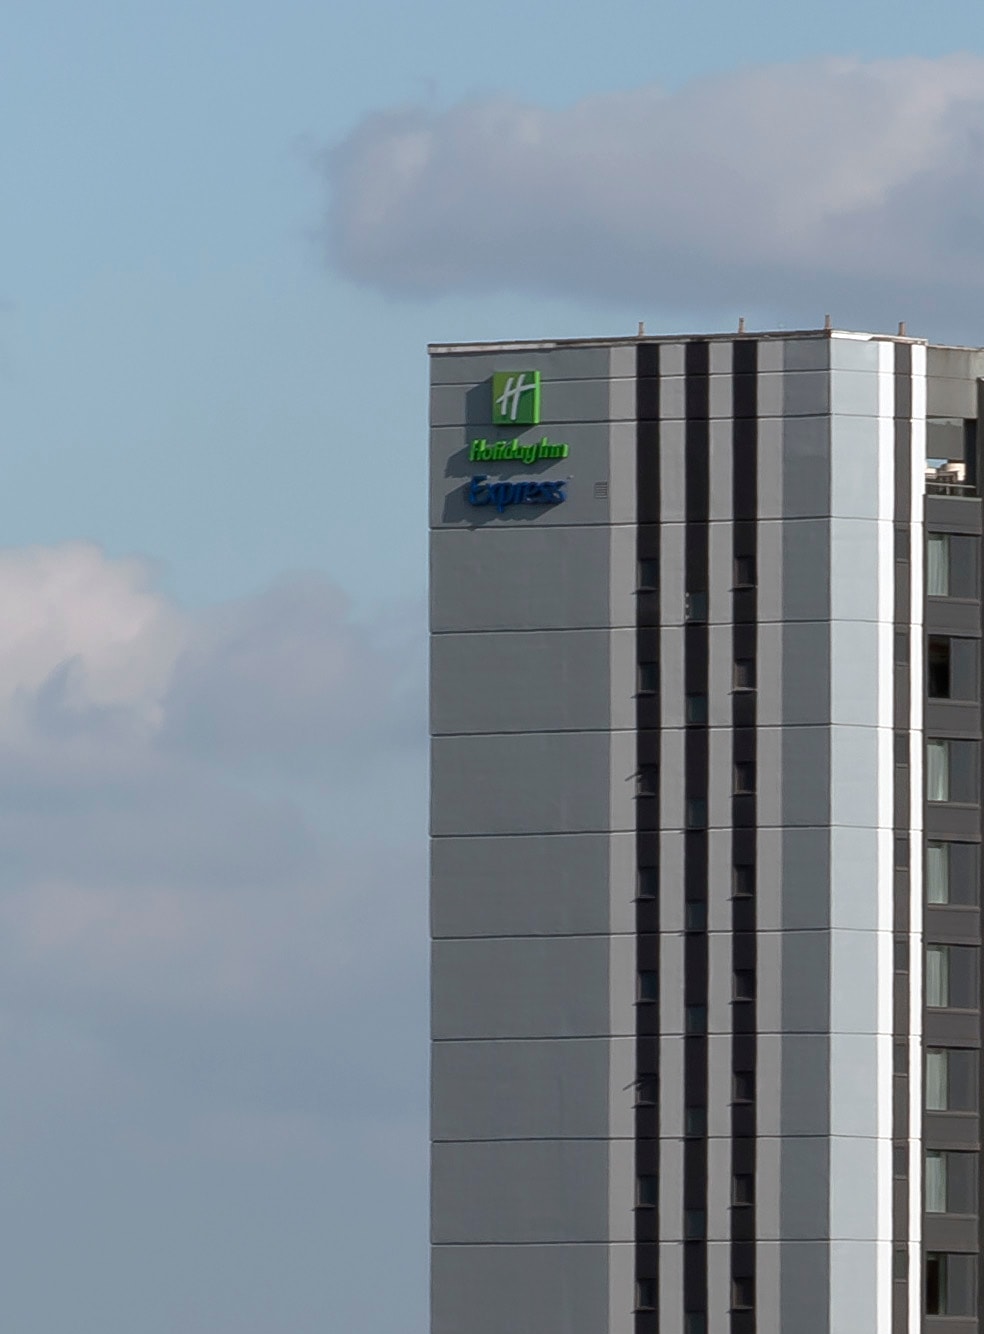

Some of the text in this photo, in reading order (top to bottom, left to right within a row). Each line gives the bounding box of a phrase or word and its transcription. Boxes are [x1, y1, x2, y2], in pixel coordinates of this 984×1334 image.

[470, 437, 568, 464] Holiday Inn
[470, 474, 566, 512] Express
